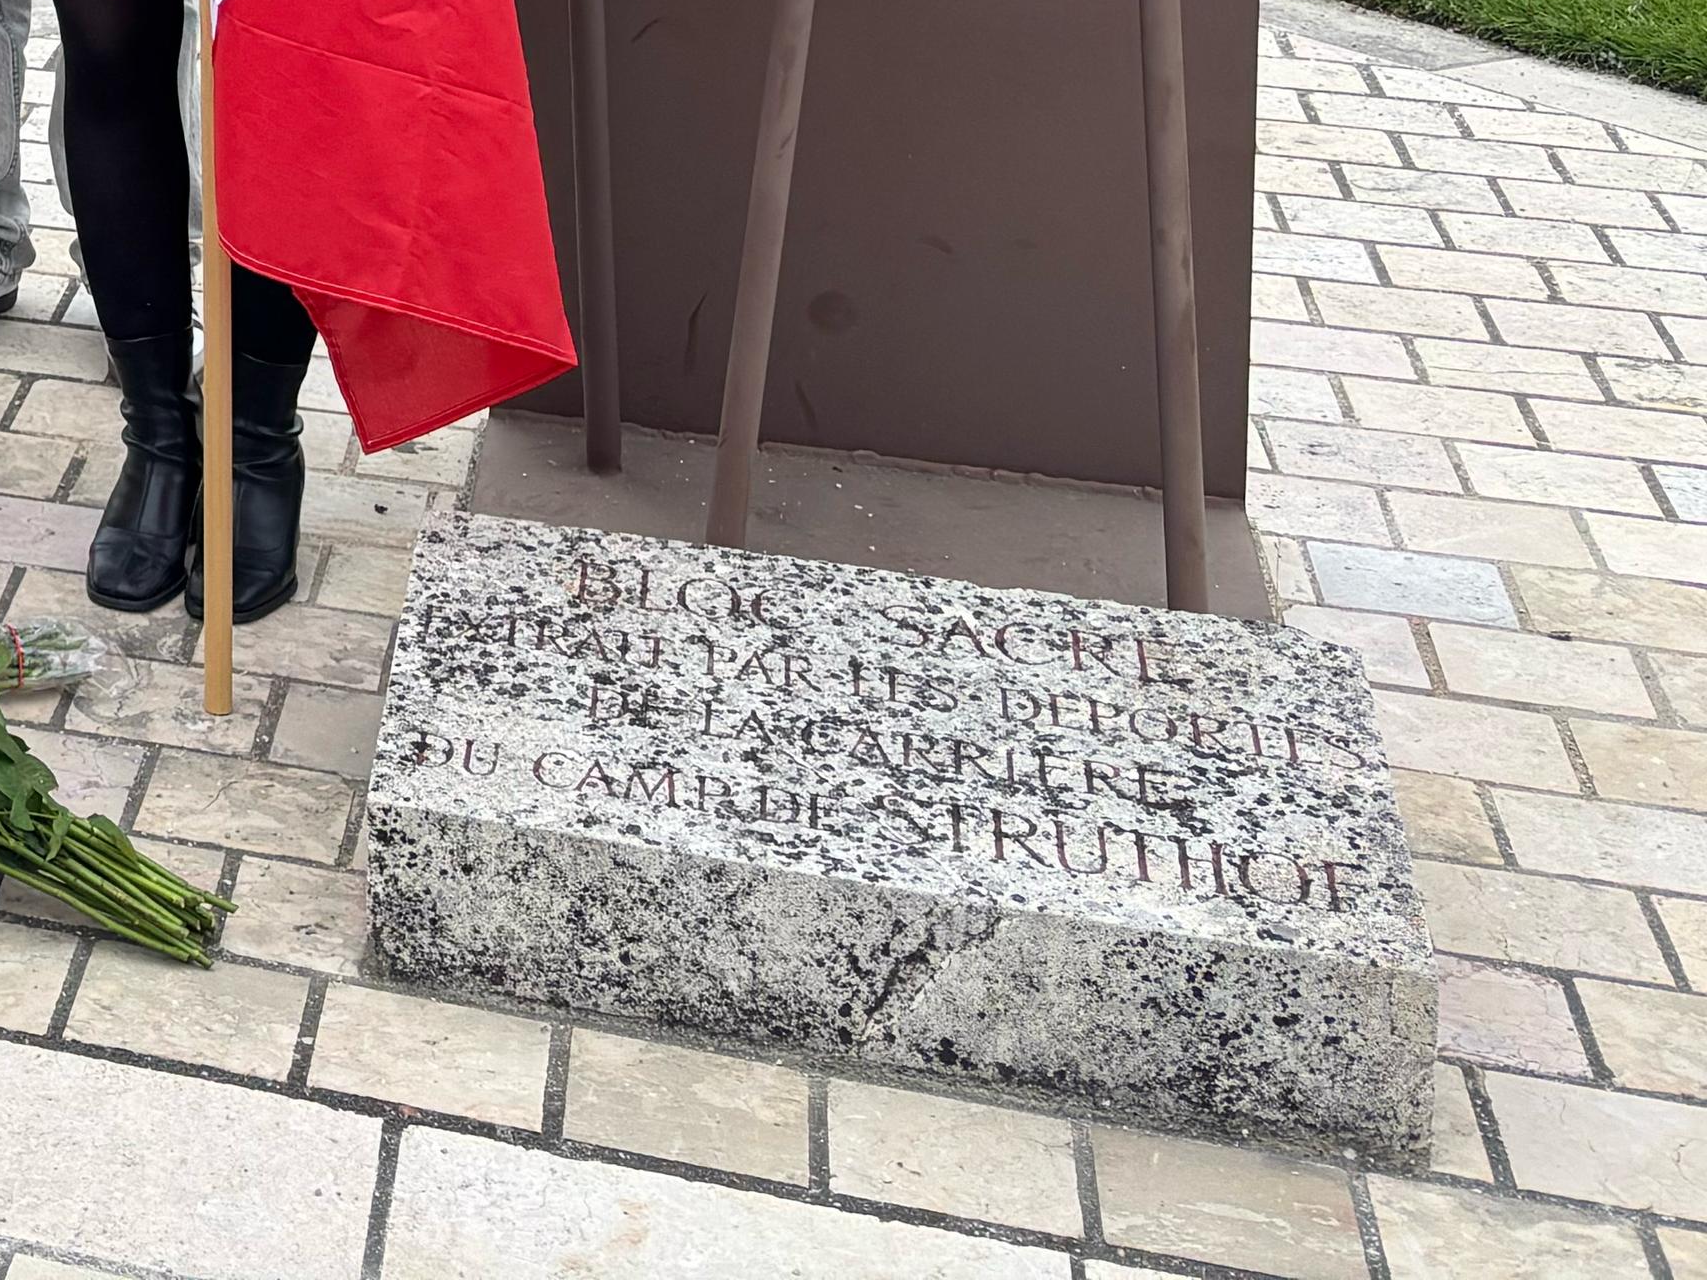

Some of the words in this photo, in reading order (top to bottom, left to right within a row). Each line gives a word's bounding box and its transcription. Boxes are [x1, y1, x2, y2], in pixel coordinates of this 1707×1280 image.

[576, 560, 811, 634] BLOC
[699, 639, 822, 692] PAR
[849, 655, 959, 712] LES
[701, 702, 777, 746] LA
[414, 731, 502, 776] DU
[531, 751, 732, 812] CAMP
[757, 785, 839, 830] DE
[875, 792, 1368, 913] STRUTHOF
